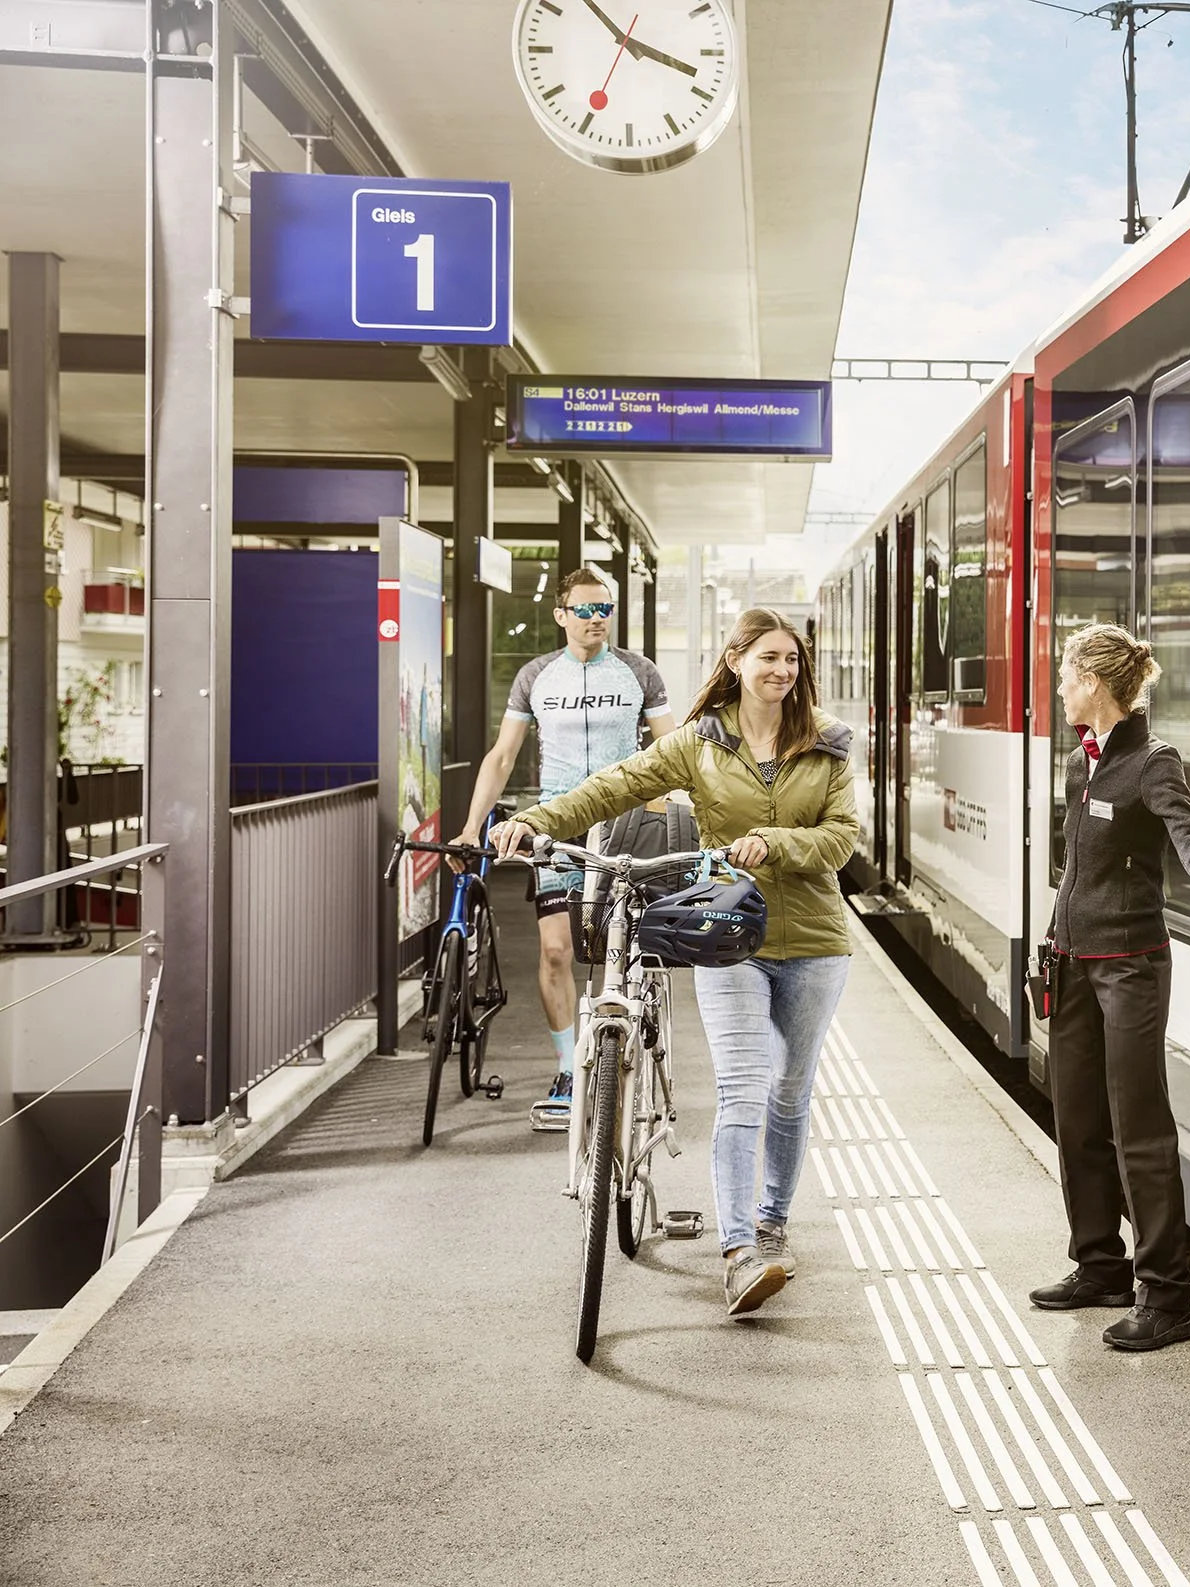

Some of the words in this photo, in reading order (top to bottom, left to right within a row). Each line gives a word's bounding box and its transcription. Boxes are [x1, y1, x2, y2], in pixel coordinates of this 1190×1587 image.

[371, 207, 416, 224] Gleis
[404, 234, 434, 311] 1
[525, 388, 540, 397] S4
[566, 388, 607, 400] 16:01
[612, 389, 660, 401] Luzern
[564, 401, 615, 412] Dallenwil
[620, 403, 652, 413] Stans
[657, 404, 709, 415] Hergiswil
[714, 404, 800, 416] Allmend/Messe
[543, 694, 633, 711] SURAL
[702, 911, 731, 921] GIRO
